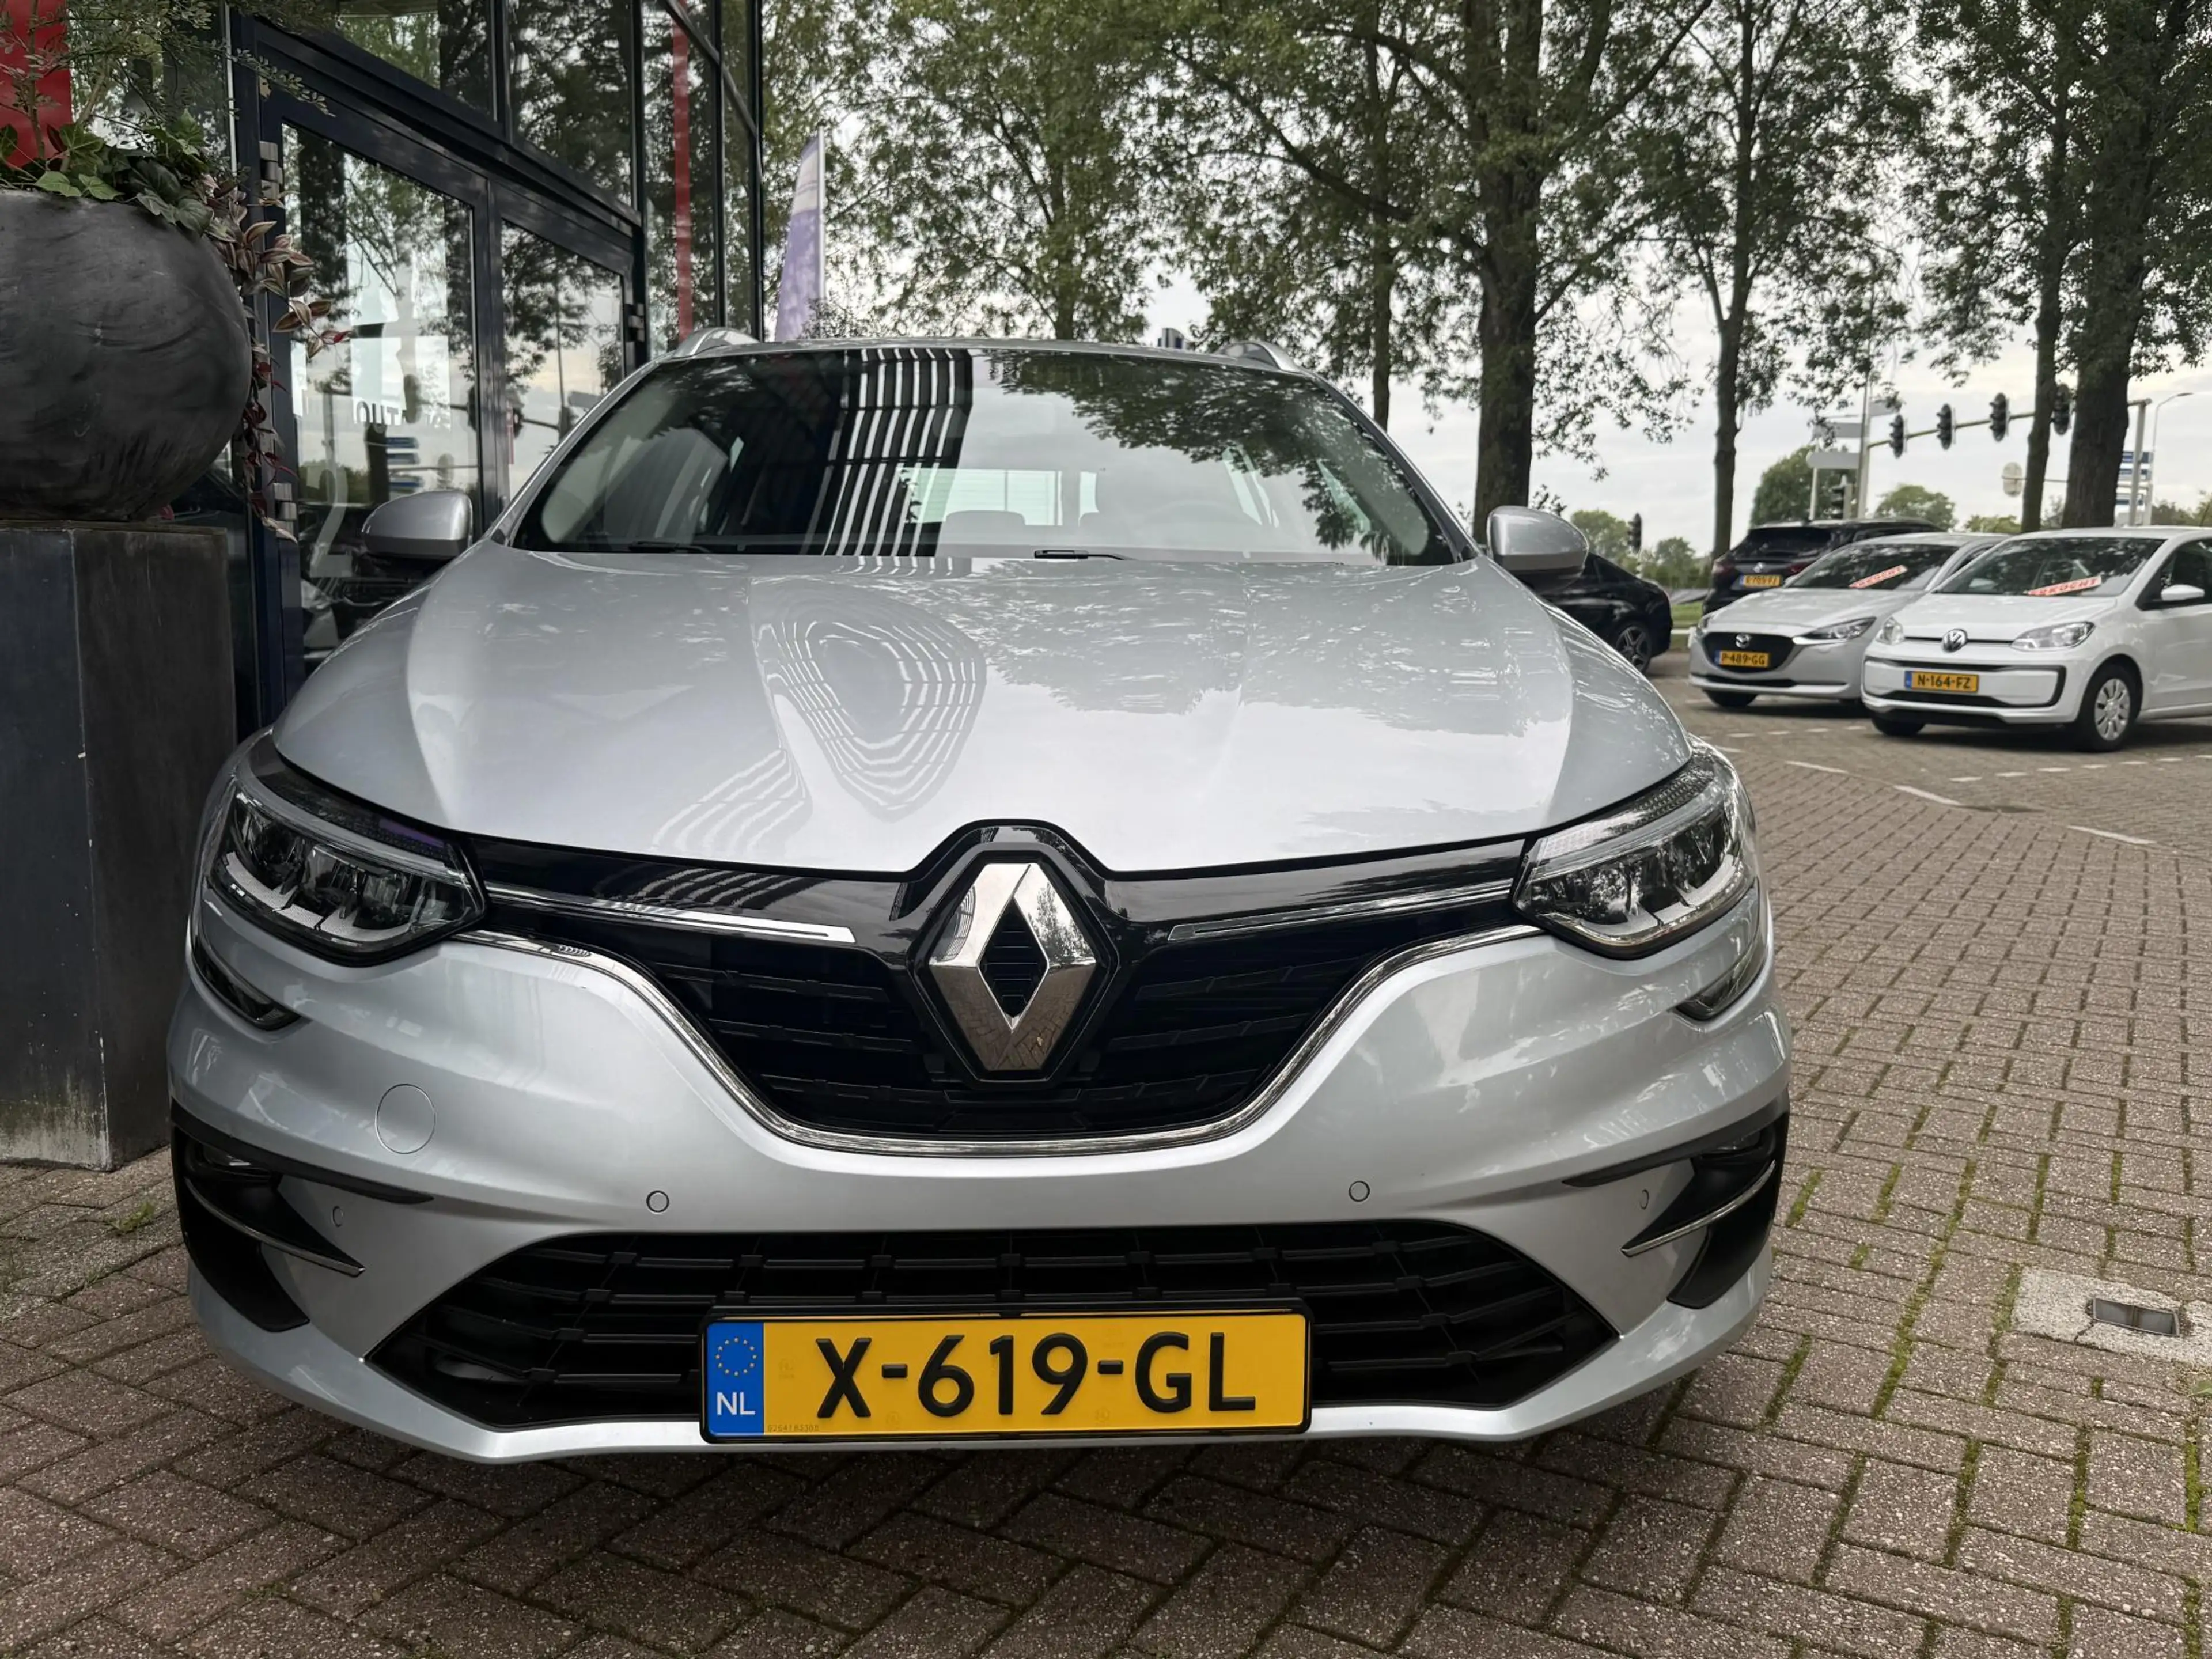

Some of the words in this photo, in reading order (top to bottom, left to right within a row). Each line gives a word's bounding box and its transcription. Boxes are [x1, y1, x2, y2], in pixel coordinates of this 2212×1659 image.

[1722, 653, 1765, 665] P-489-GG
[1918, 675, 1971, 689] N-164-FZ
[815, 1331, 1256, 1418] X-619-GL
[717, 1391, 756, 1416] NL
